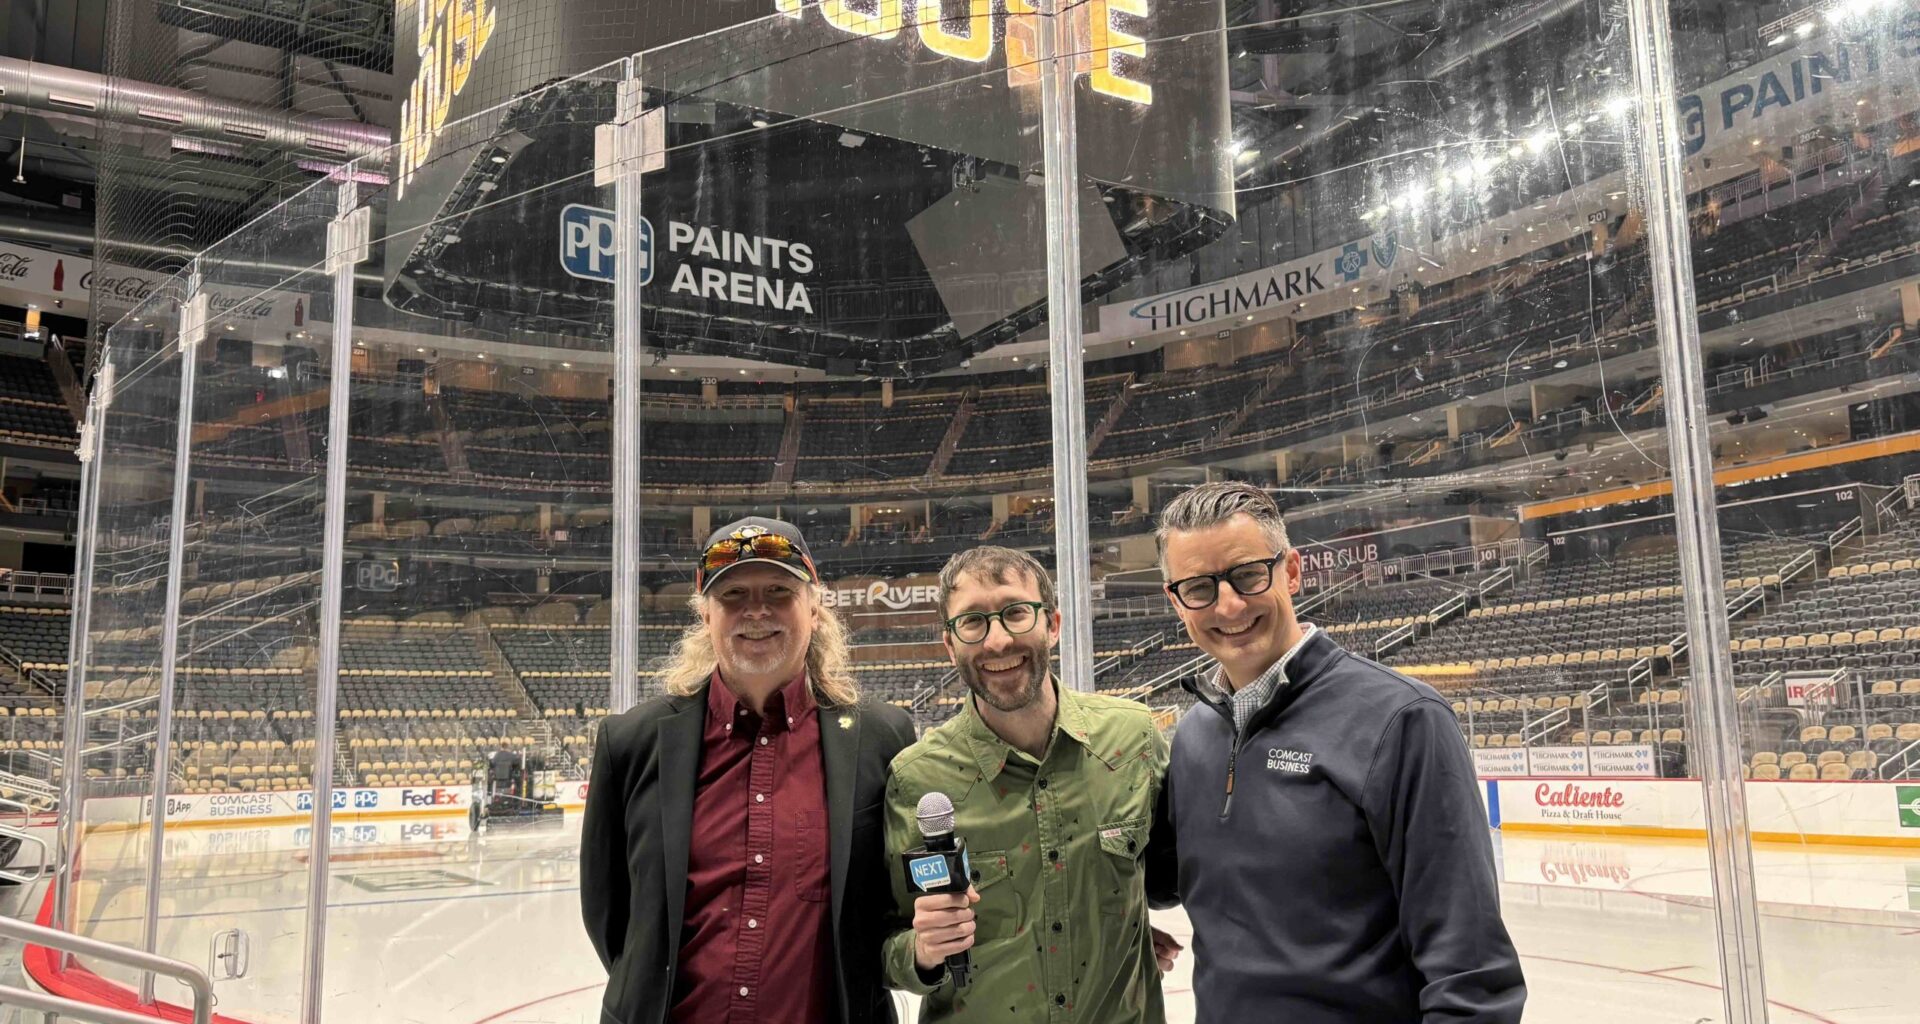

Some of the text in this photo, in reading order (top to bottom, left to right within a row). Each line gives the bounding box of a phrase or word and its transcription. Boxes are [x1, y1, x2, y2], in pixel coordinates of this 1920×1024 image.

[1589, 209, 1606, 224] 201
[669, 221, 814, 273] PAINTS
[670, 264, 814, 314] ARENA
[1150, 264, 1325, 331] HIGHMARK
[701, 377, 717, 385] 230
[1836, 490, 1854, 502] 102
[1553, 536, 1566, 546] 102
[1337, 543, 1378, 566] CLUB
[1481, 550, 1497, 562] 101
[359, 563, 398, 589] PPG
[536, 568, 551, 576] 119
[1384, 565, 1398, 576] 101
[1303, 578, 1317, 588] 122
[1268, 748, 1313, 763] COMCAST
[1267, 759, 1310, 774] BUSINESS
[210, 794, 274, 806] COMCAST
[355, 790, 378, 807] PPG
[402, 789, 459, 806] FedEx
[1535, 783, 1625, 808] Caliente
[210, 805, 273, 816] BUSINESS
[1541, 809, 1561, 818] Pizza
[1573, 809, 1594, 819] Draft
[1596, 810, 1622, 820] House
[914, 861, 942, 877] NEXT
